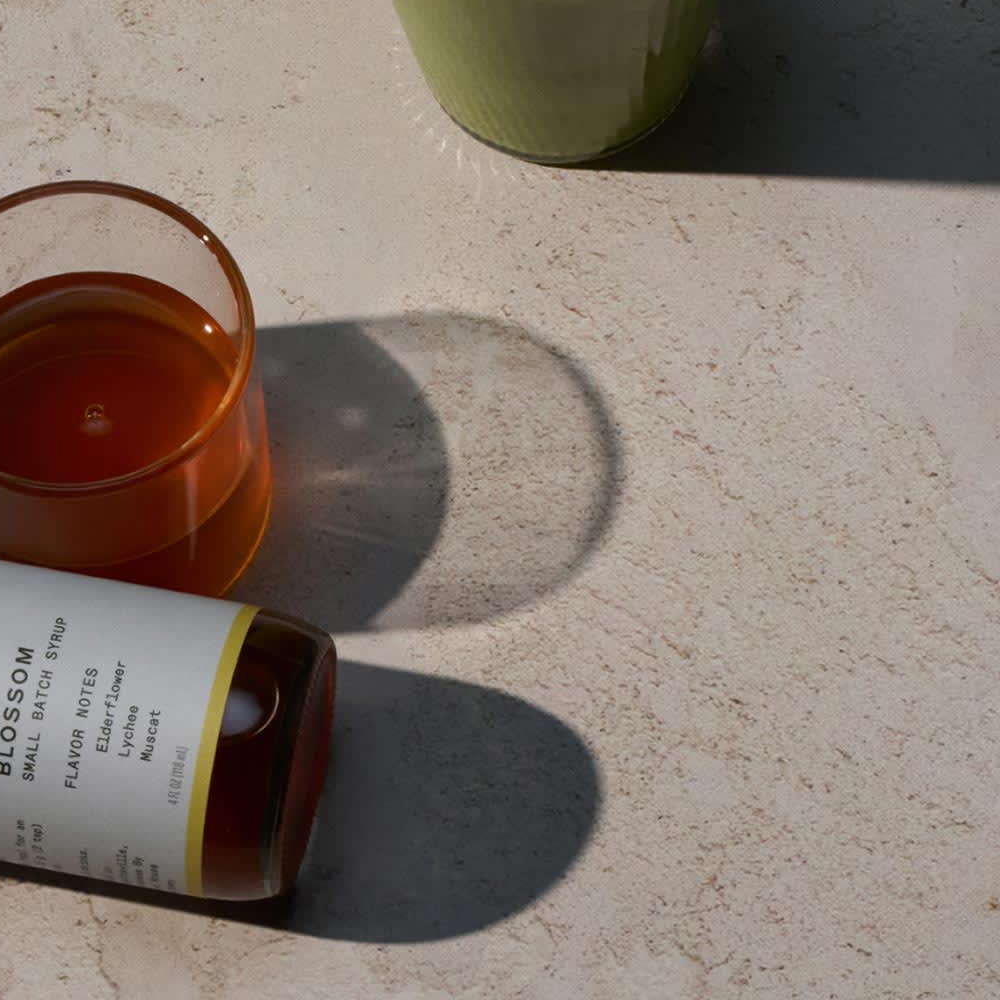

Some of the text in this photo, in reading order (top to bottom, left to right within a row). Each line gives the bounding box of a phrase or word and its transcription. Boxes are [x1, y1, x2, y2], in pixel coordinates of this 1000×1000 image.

[22, 616, 68, 781] SMALL BATCH SYRUP
[64, 667, 98, 789] FLAVOR NOTES
[95, 660, 126, 753] Elderflower
[118, 705, 139, 757] Lychee
[140, 709, 161, 762] Muscat
